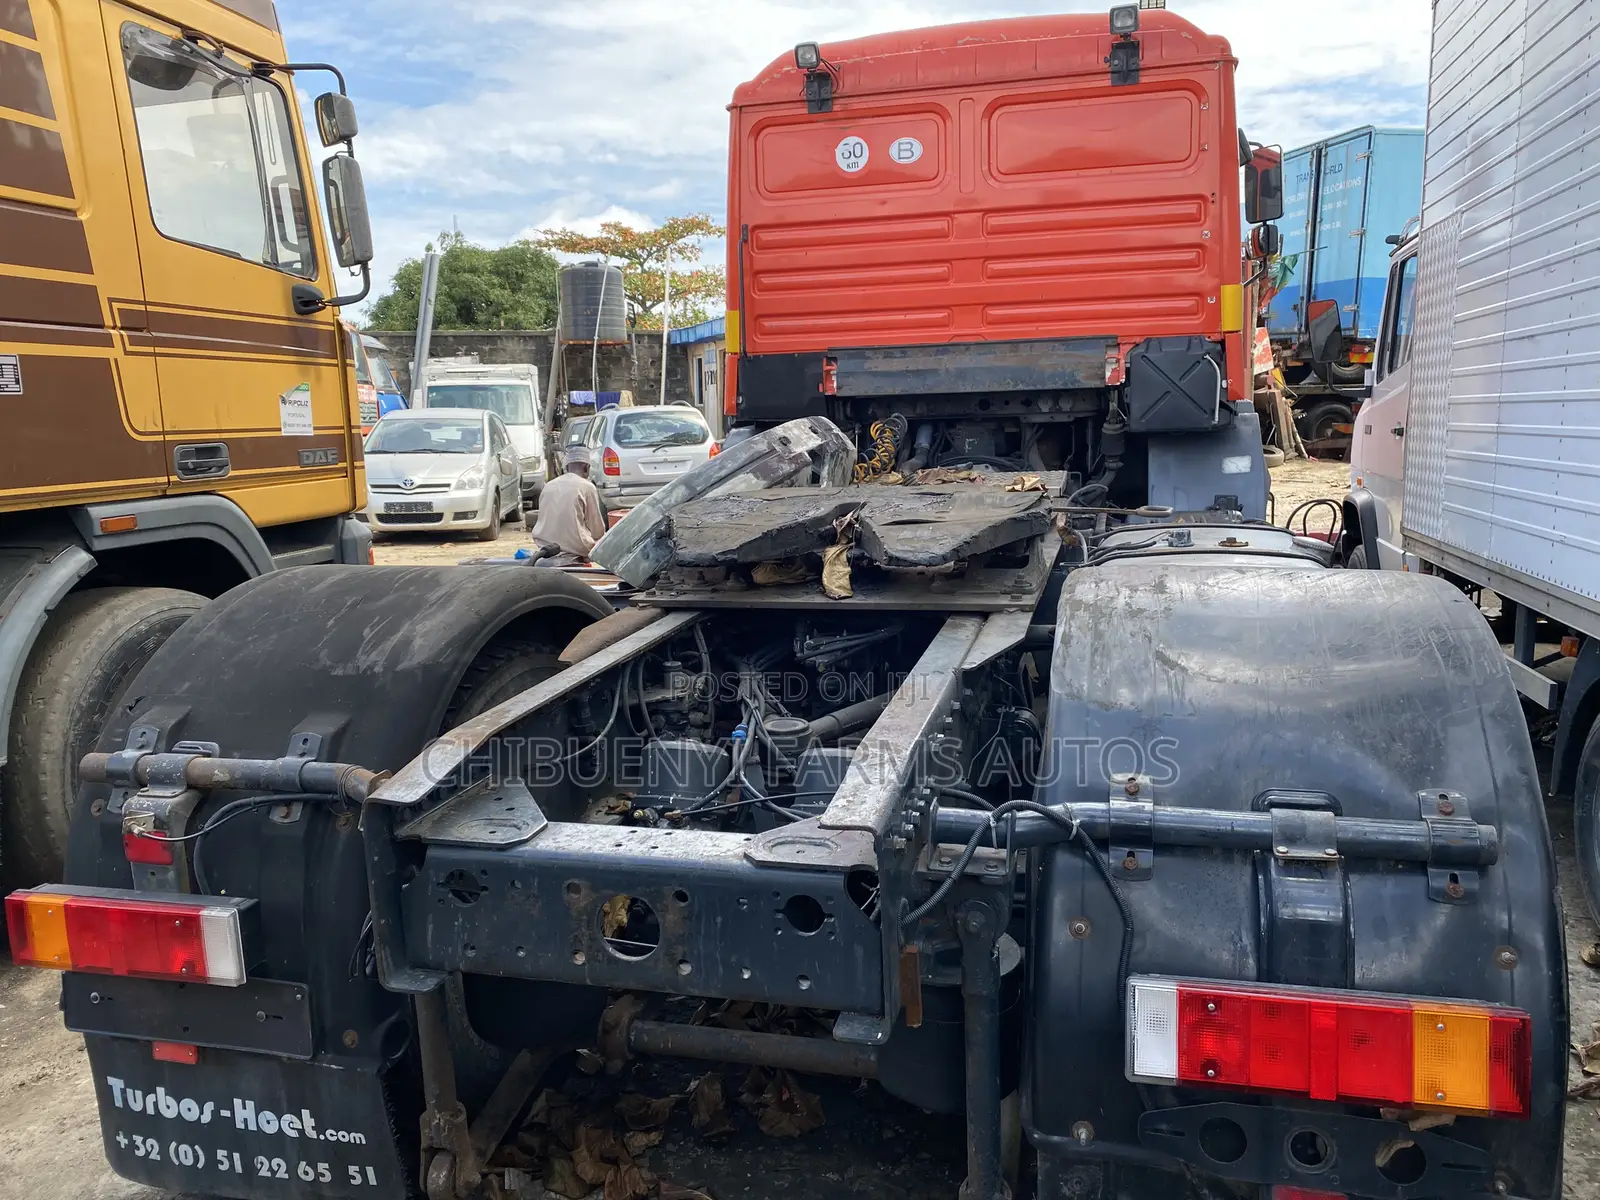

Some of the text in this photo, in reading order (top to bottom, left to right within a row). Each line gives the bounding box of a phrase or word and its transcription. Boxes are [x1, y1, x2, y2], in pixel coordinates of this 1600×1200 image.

[897, 141, 915, 160] B
[303, 450, 338, 464] DAF
[115, 1130, 378, 1186] +32 (0) 51 22 65 51
